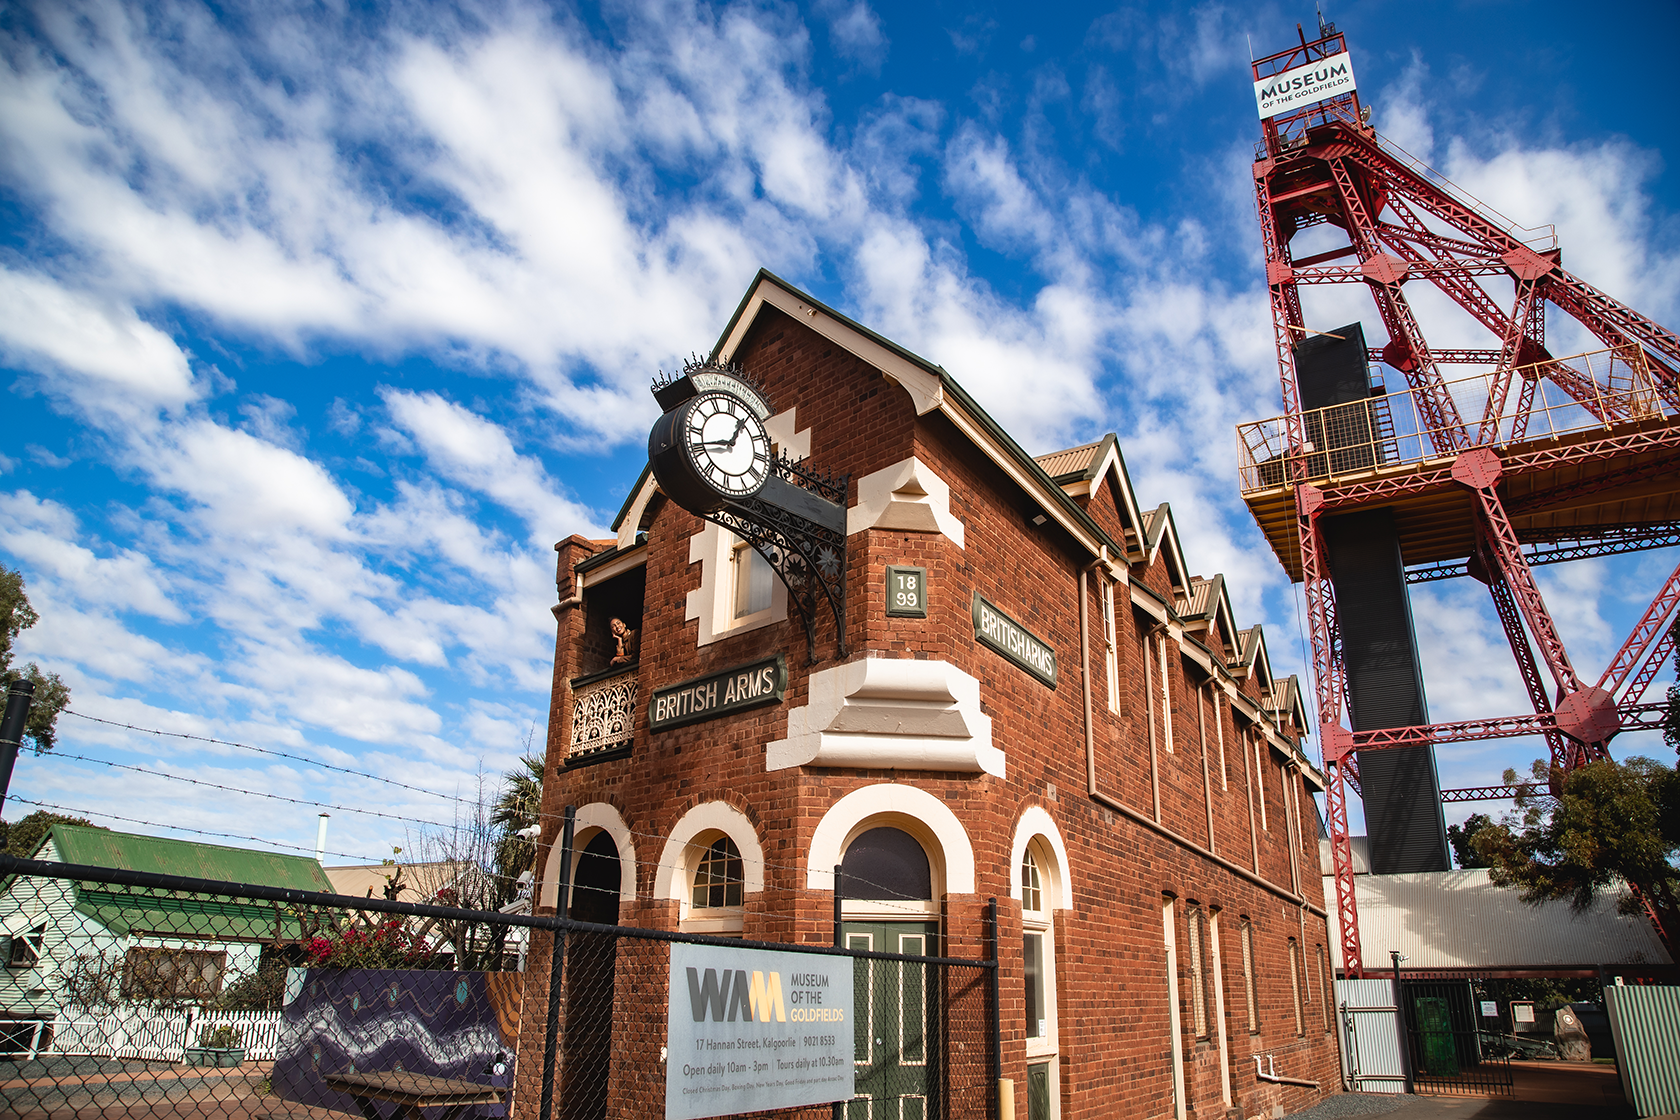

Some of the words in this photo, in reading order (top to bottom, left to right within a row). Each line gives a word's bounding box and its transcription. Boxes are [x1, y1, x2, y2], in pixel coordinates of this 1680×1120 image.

[1261, 62, 1347, 101] MUSEUM
[1262, 100, 1275, 109] OF
[1276, 94, 1293, 105] THE
[1295, 76, 1350, 99] GOLDFIELDS
[897, 575, 917, 590] 18
[896, 592, 918, 607] 99
[656, 681, 718, 722] BRITISH
[724, 666, 774, 705] ARMS
[791, 973, 829, 987] MUSEUM
[686, 967, 787, 1022] WAM
[791, 990, 804, 1004] OF
[805, 990, 822, 1004] THE
[790, 1008, 844, 1022] GOLDFIELDS
[696, 1038, 705, 1051] 17
[706, 1038, 735, 1051] Hannan
[737, 1037, 762, 1051] Street,
[762, 1036, 796, 1051] Kalgoorlie
[803, 1035, 819, 1047] 9021
[819, 1035, 836, 1046] 8533
[683, 1064, 706, 1079] Open
[707, 1062, 726, 1077] daily
[727, 1061, 747, 1073] 10am
[753, 1060, 769, 1075] 3pm
[776, 1058, 794, 1070] Tours
[795, 1057, 811, 1071] daily
[811, 1058, 818, 1068] at
[819, 1056, 845, 1067] 10.30am
[682, 1087, 698, 1095] Closed
[699, 1085, 721, 1094] Christmas
[732, 1083, 746, 1092] Boxing
